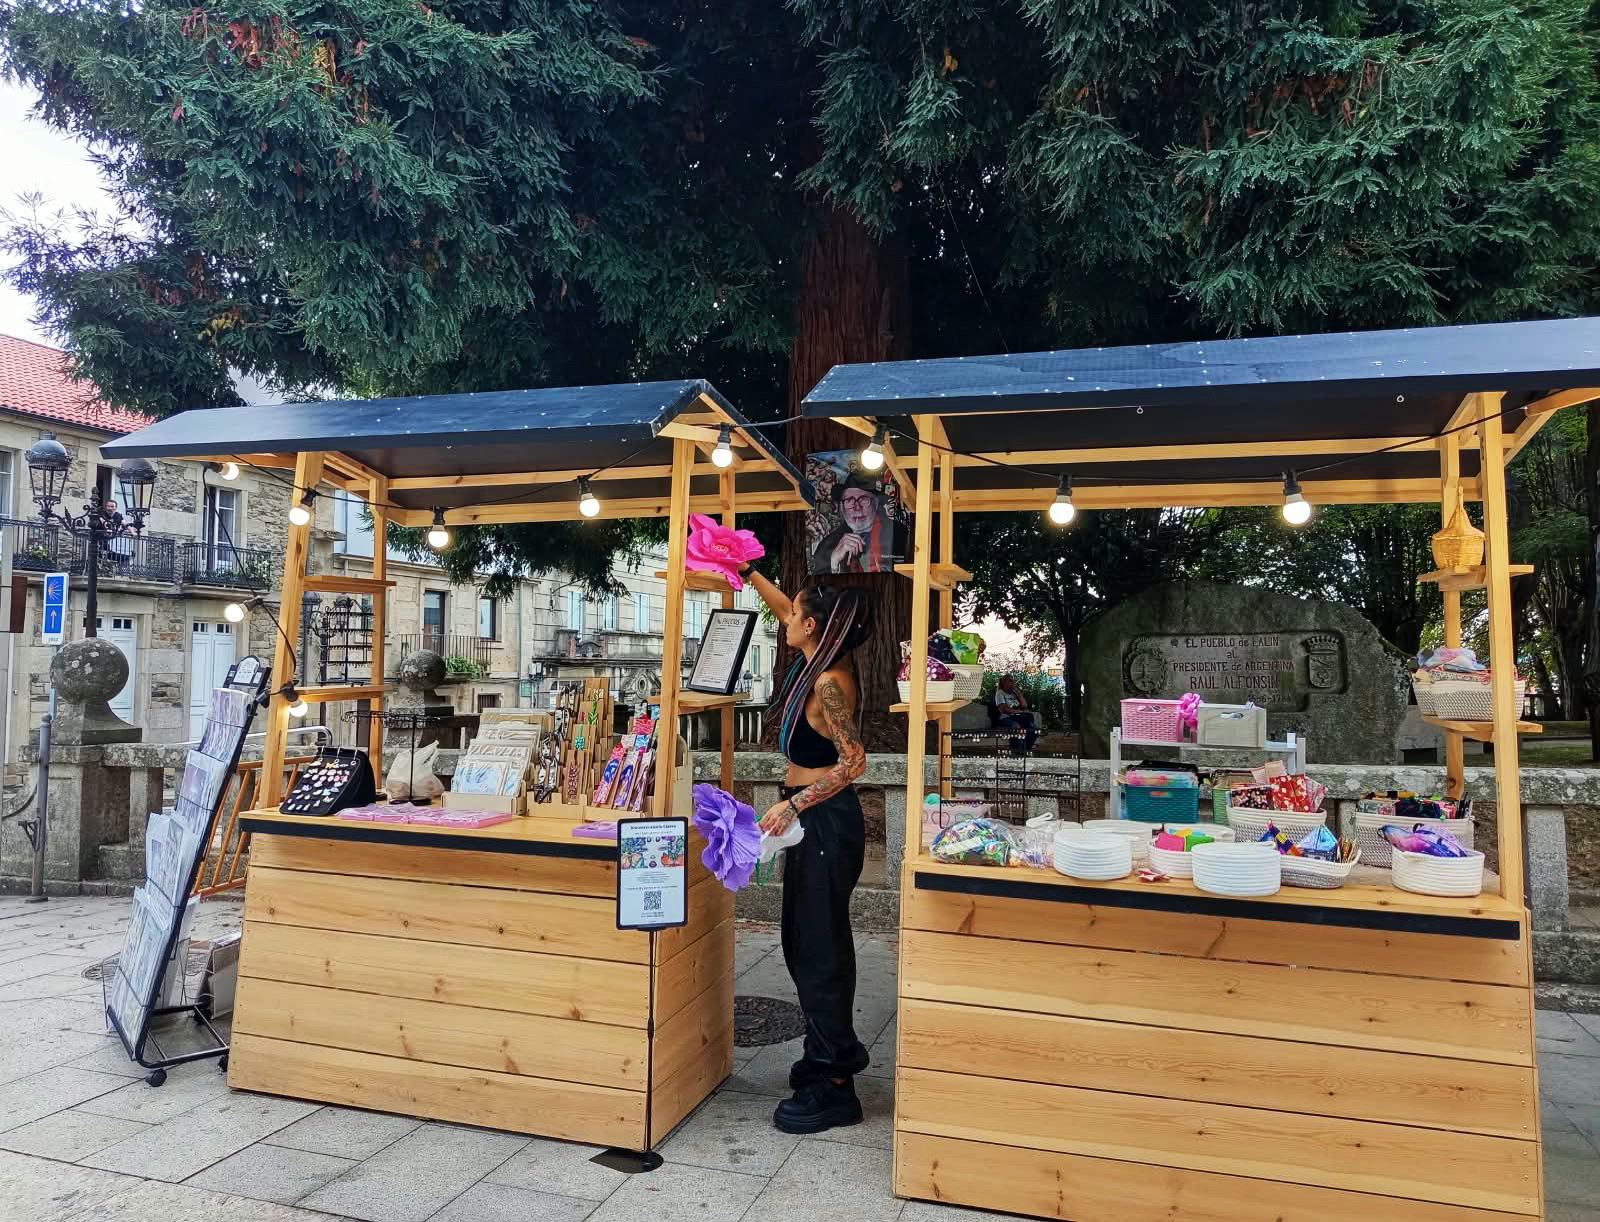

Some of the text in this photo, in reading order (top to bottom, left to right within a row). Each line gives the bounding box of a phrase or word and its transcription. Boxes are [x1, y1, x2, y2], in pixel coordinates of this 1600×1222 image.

[1185, 638, 1198, 648] EL
[1200, 638, 1235, 648] PUEBLO
[1238, 637, 1249, 647] de
[1226, 648, 1237, 659] al
[1173, 660, 1295, 672] PRESIDENTE de ARGENTINA
